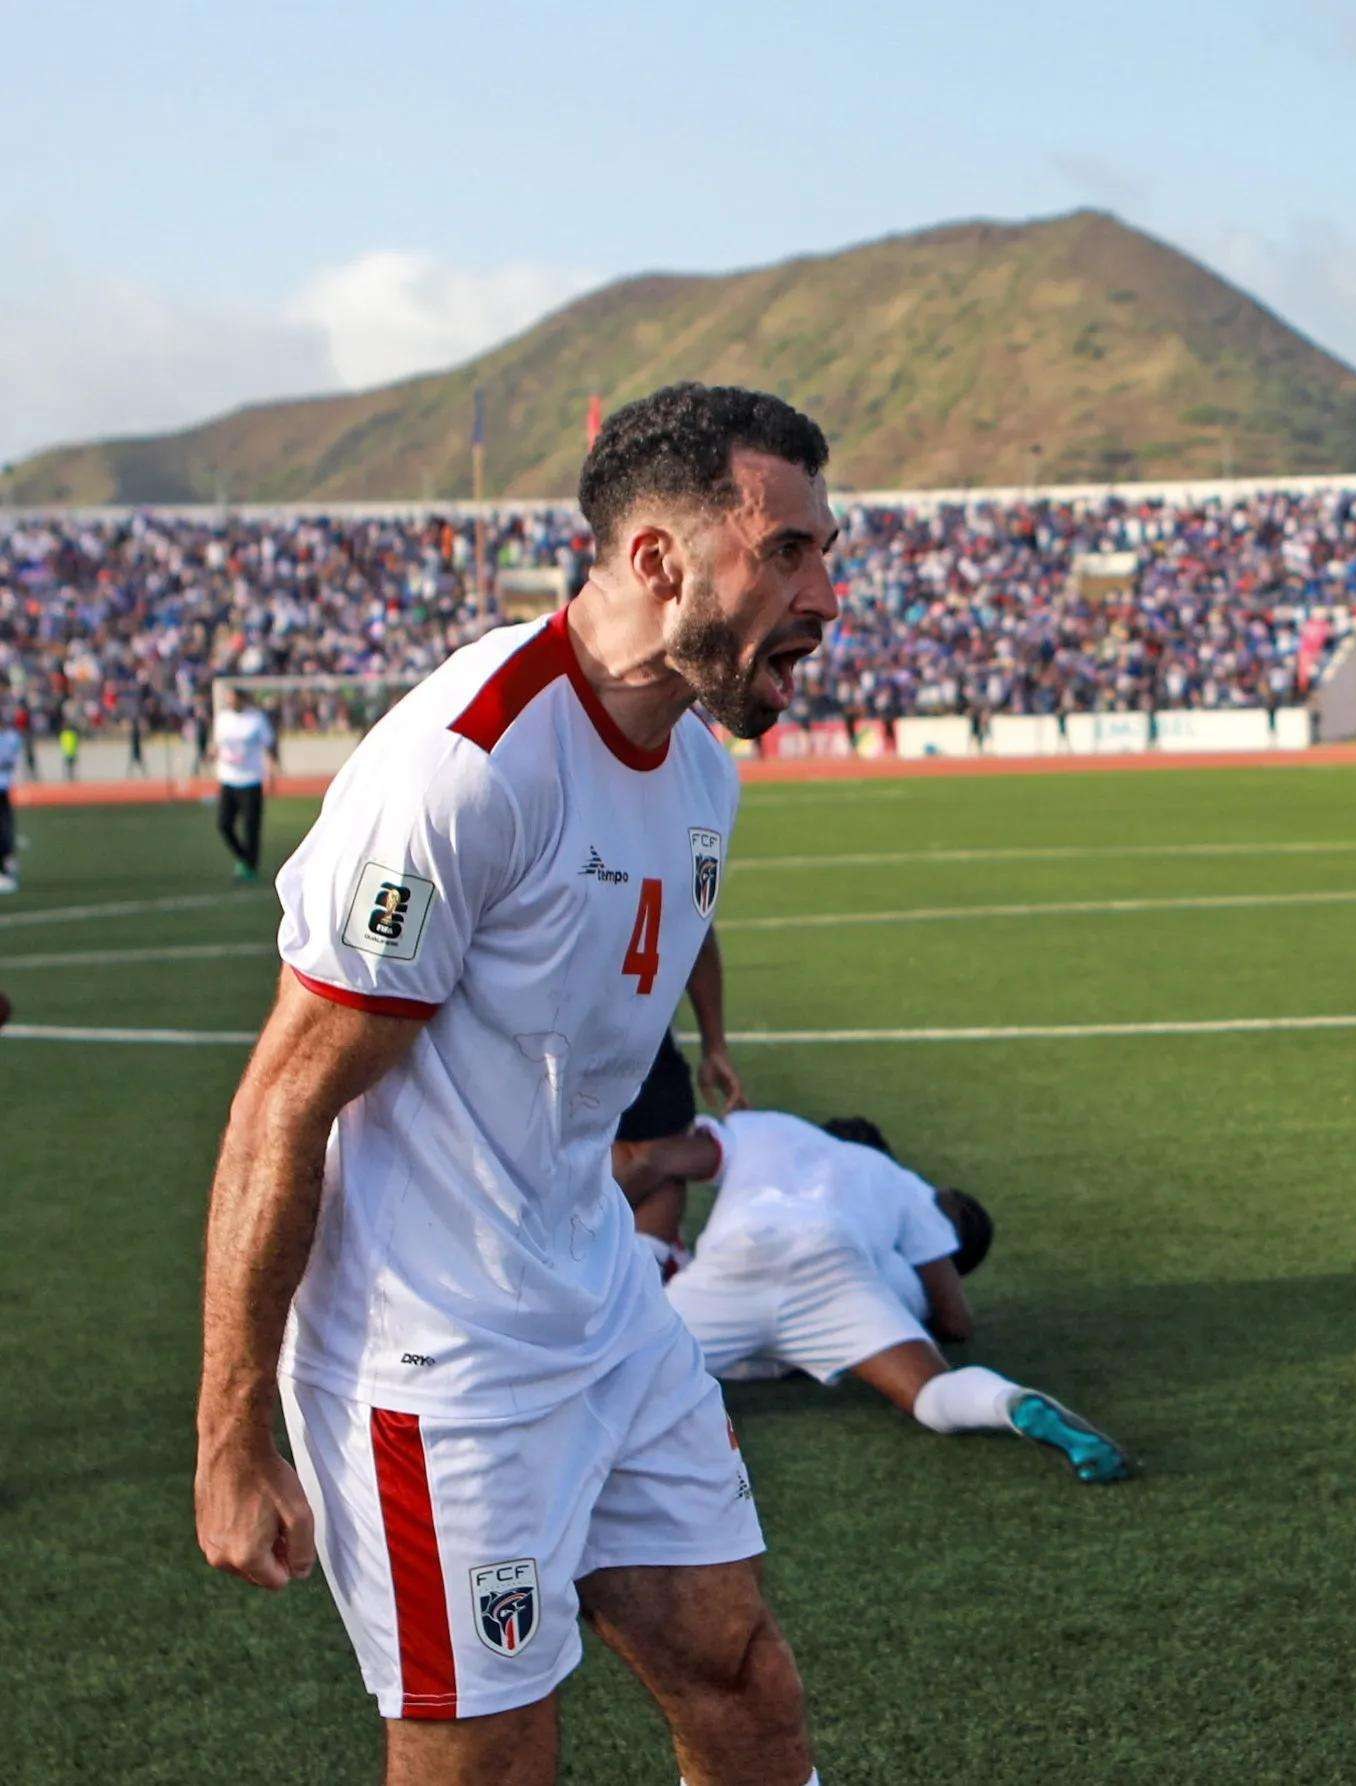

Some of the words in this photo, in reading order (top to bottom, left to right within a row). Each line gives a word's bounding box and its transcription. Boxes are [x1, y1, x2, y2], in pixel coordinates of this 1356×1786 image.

[691, 833, 718, 848] FCF
[597, 868, 629, 884] tempo
[621, 878, 662, 994] 4
[476, 1564, 530, 1586] FCF
